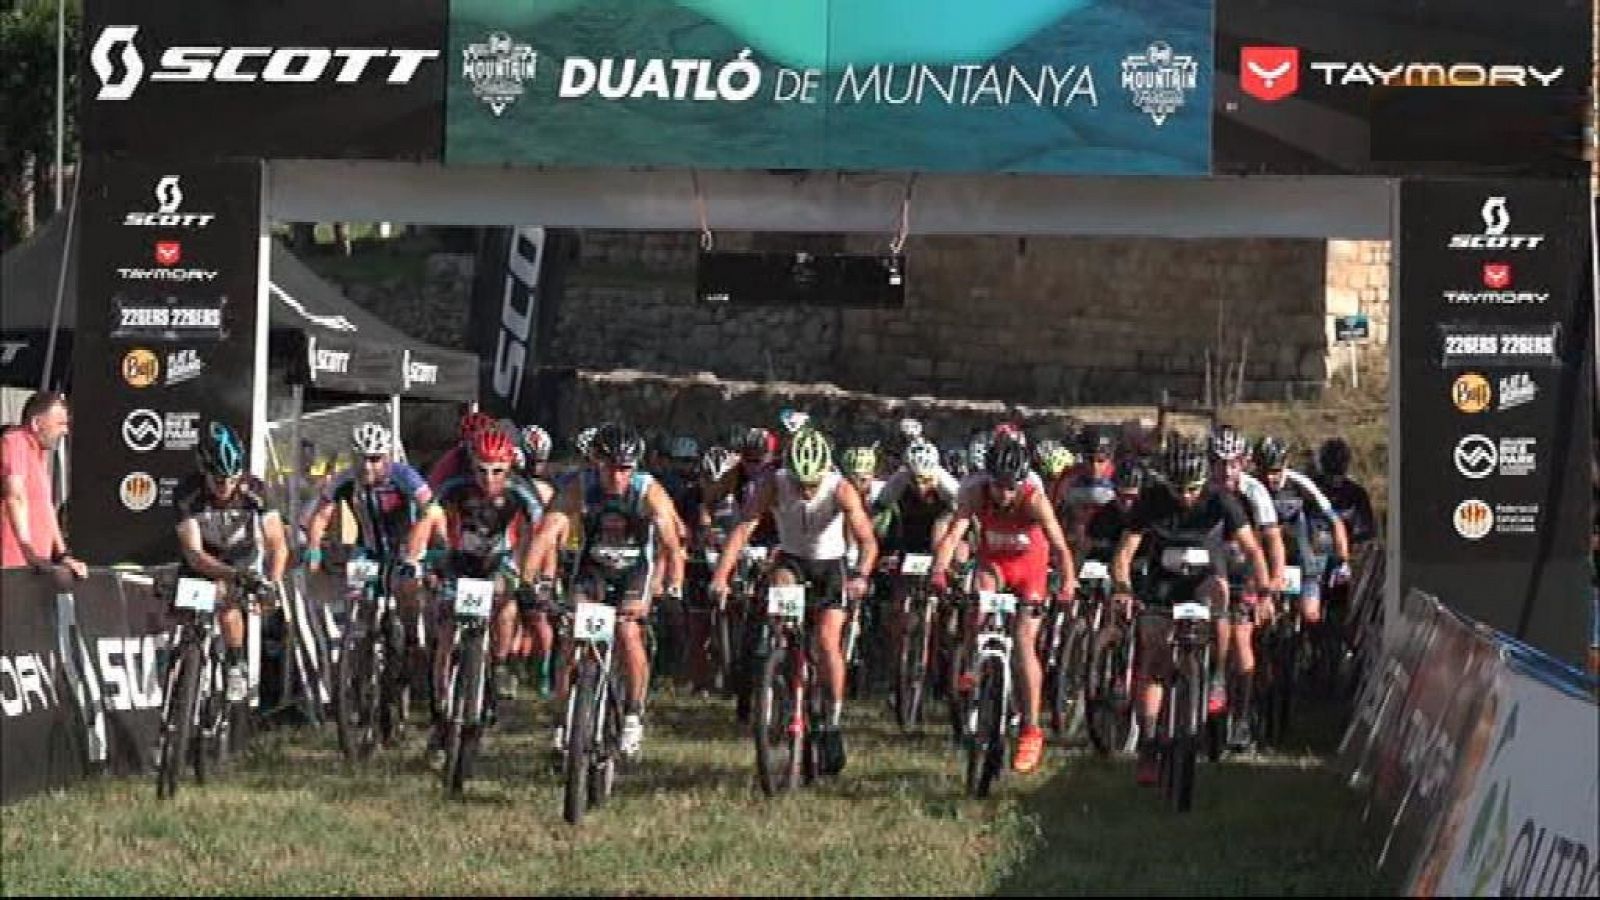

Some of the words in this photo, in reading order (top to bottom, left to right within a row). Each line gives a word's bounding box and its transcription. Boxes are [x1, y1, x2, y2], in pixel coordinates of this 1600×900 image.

[151, 46, 440, 82] SCOTT
[1310, 61, 1565, 87] TAYMORY
[559, 49, 762, 101] DUATLÓ
[774, 67, 822, 103] DE
[835, 62, 1099, 107] MUNTANYA
[123, 212, 216, 226] SCOTT
[1447, 233, 1545, 249] SCOTT
[1443, 290, 1550, 304] TAYMORY
